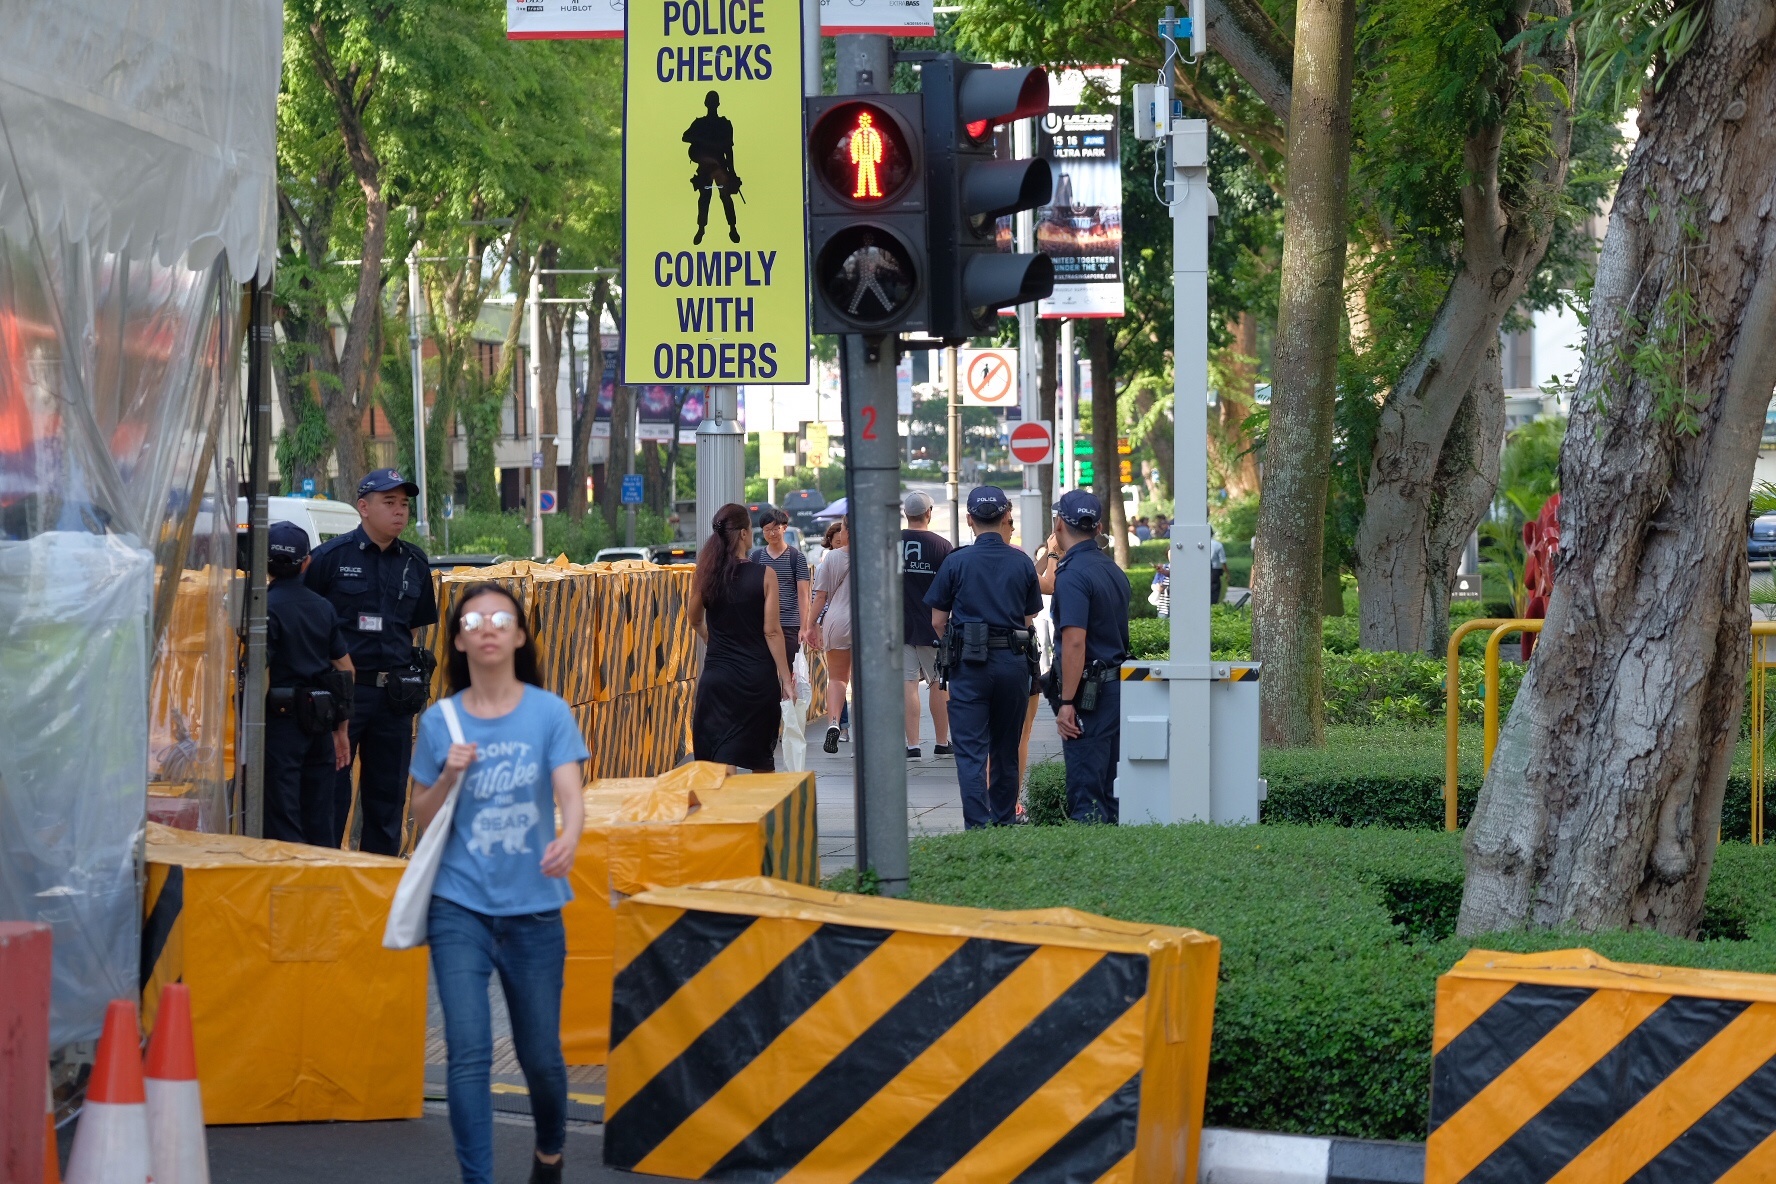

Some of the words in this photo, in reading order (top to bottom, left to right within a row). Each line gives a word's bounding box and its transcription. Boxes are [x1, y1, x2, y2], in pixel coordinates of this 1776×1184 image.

[664, 0, 765, 36] POLICE
[656, 44, 772, 83] CHECKS
[1052, 136, 1063, 146] 15
[1067, 136, 1078, 146] 16
[1085, 136, 1105, 145] JUNE
[1053, 149, 1081, 157] ULTRA
[1082, 148, 1106, 157] PARK
[654, 251, 777, 287] COMPLY
[1077, 256, 1115, 264] TOGETHER
[676, 297, 754, 333] WITH
[654, 342, 777, 379] ORDERS
[861, 405, 877, 440] 2
[1077, 507, 1097, 516] POLICE
[271, 543, 296, 553] POLICE
[477, 741, 531, 761] DON'T
[465, 757, 539, 800] Wake
[482, 814, 529, 831] BEAR
